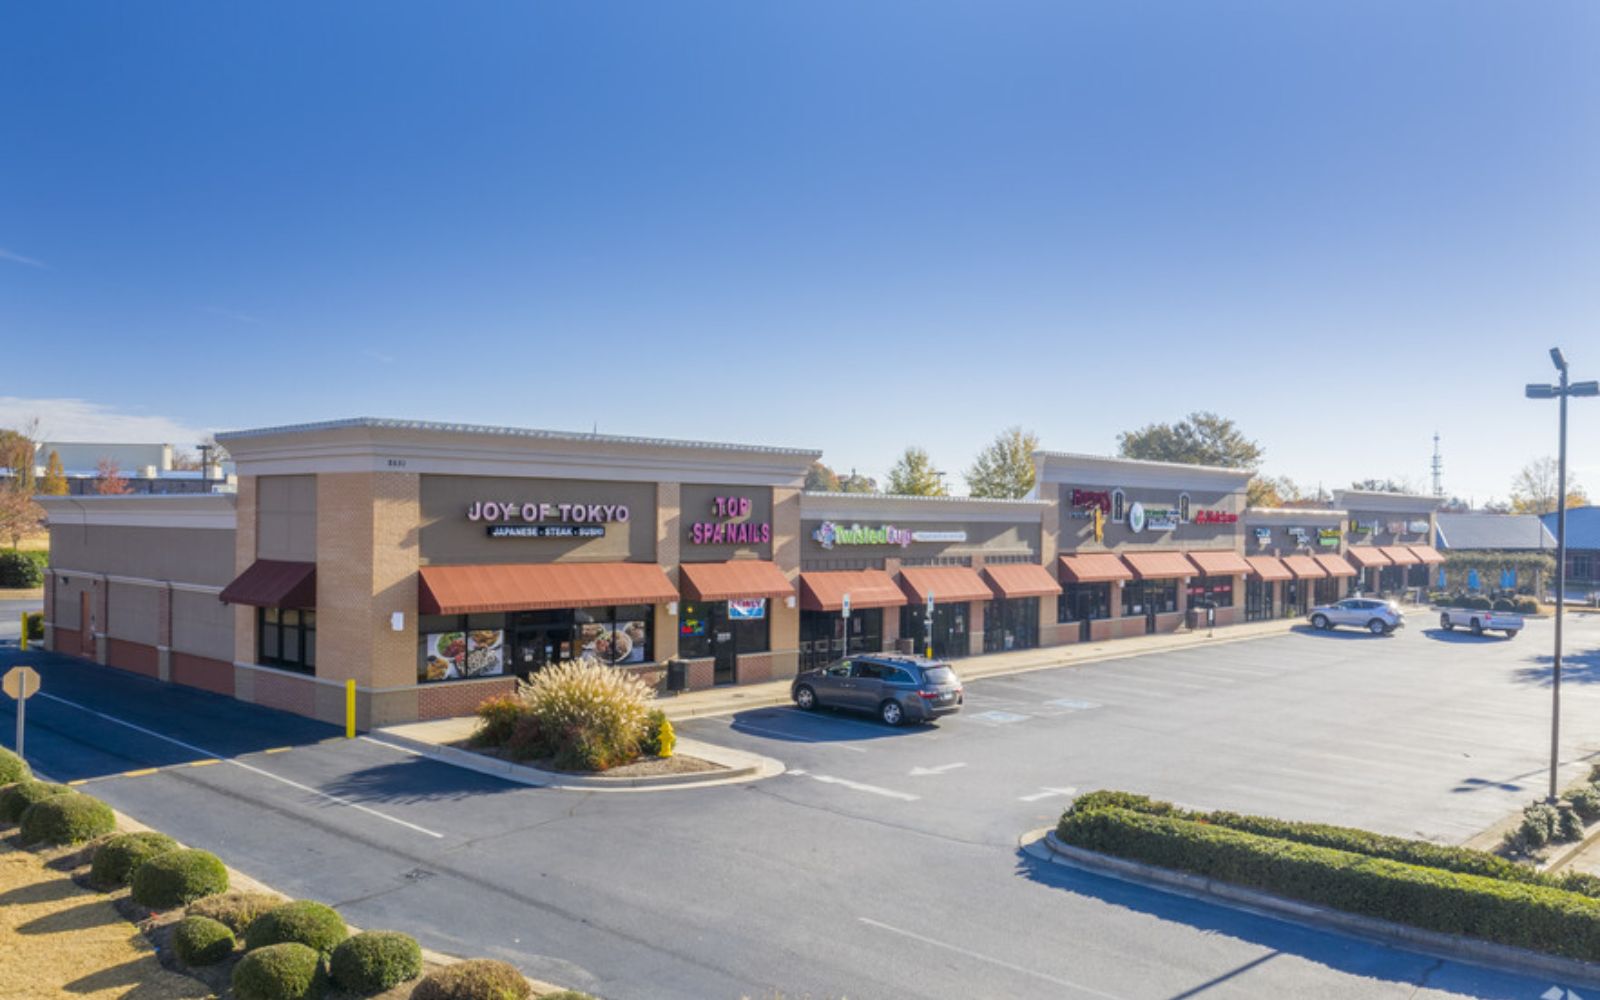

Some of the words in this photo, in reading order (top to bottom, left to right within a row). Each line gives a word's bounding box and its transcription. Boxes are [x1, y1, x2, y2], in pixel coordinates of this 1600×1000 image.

[468, 502, 513, 521] JOY
[522, 503, 550, 521] OF
[559, 504, 629, 522] TOKYO
[715, 496, 749, 517] TOP
[493, 527, 538, 537] JAPANESE
[545, 527, 573, 536] STEAK
[693, 522, 722, 544] SPA
[727, 522, 769, 544] NAILS
